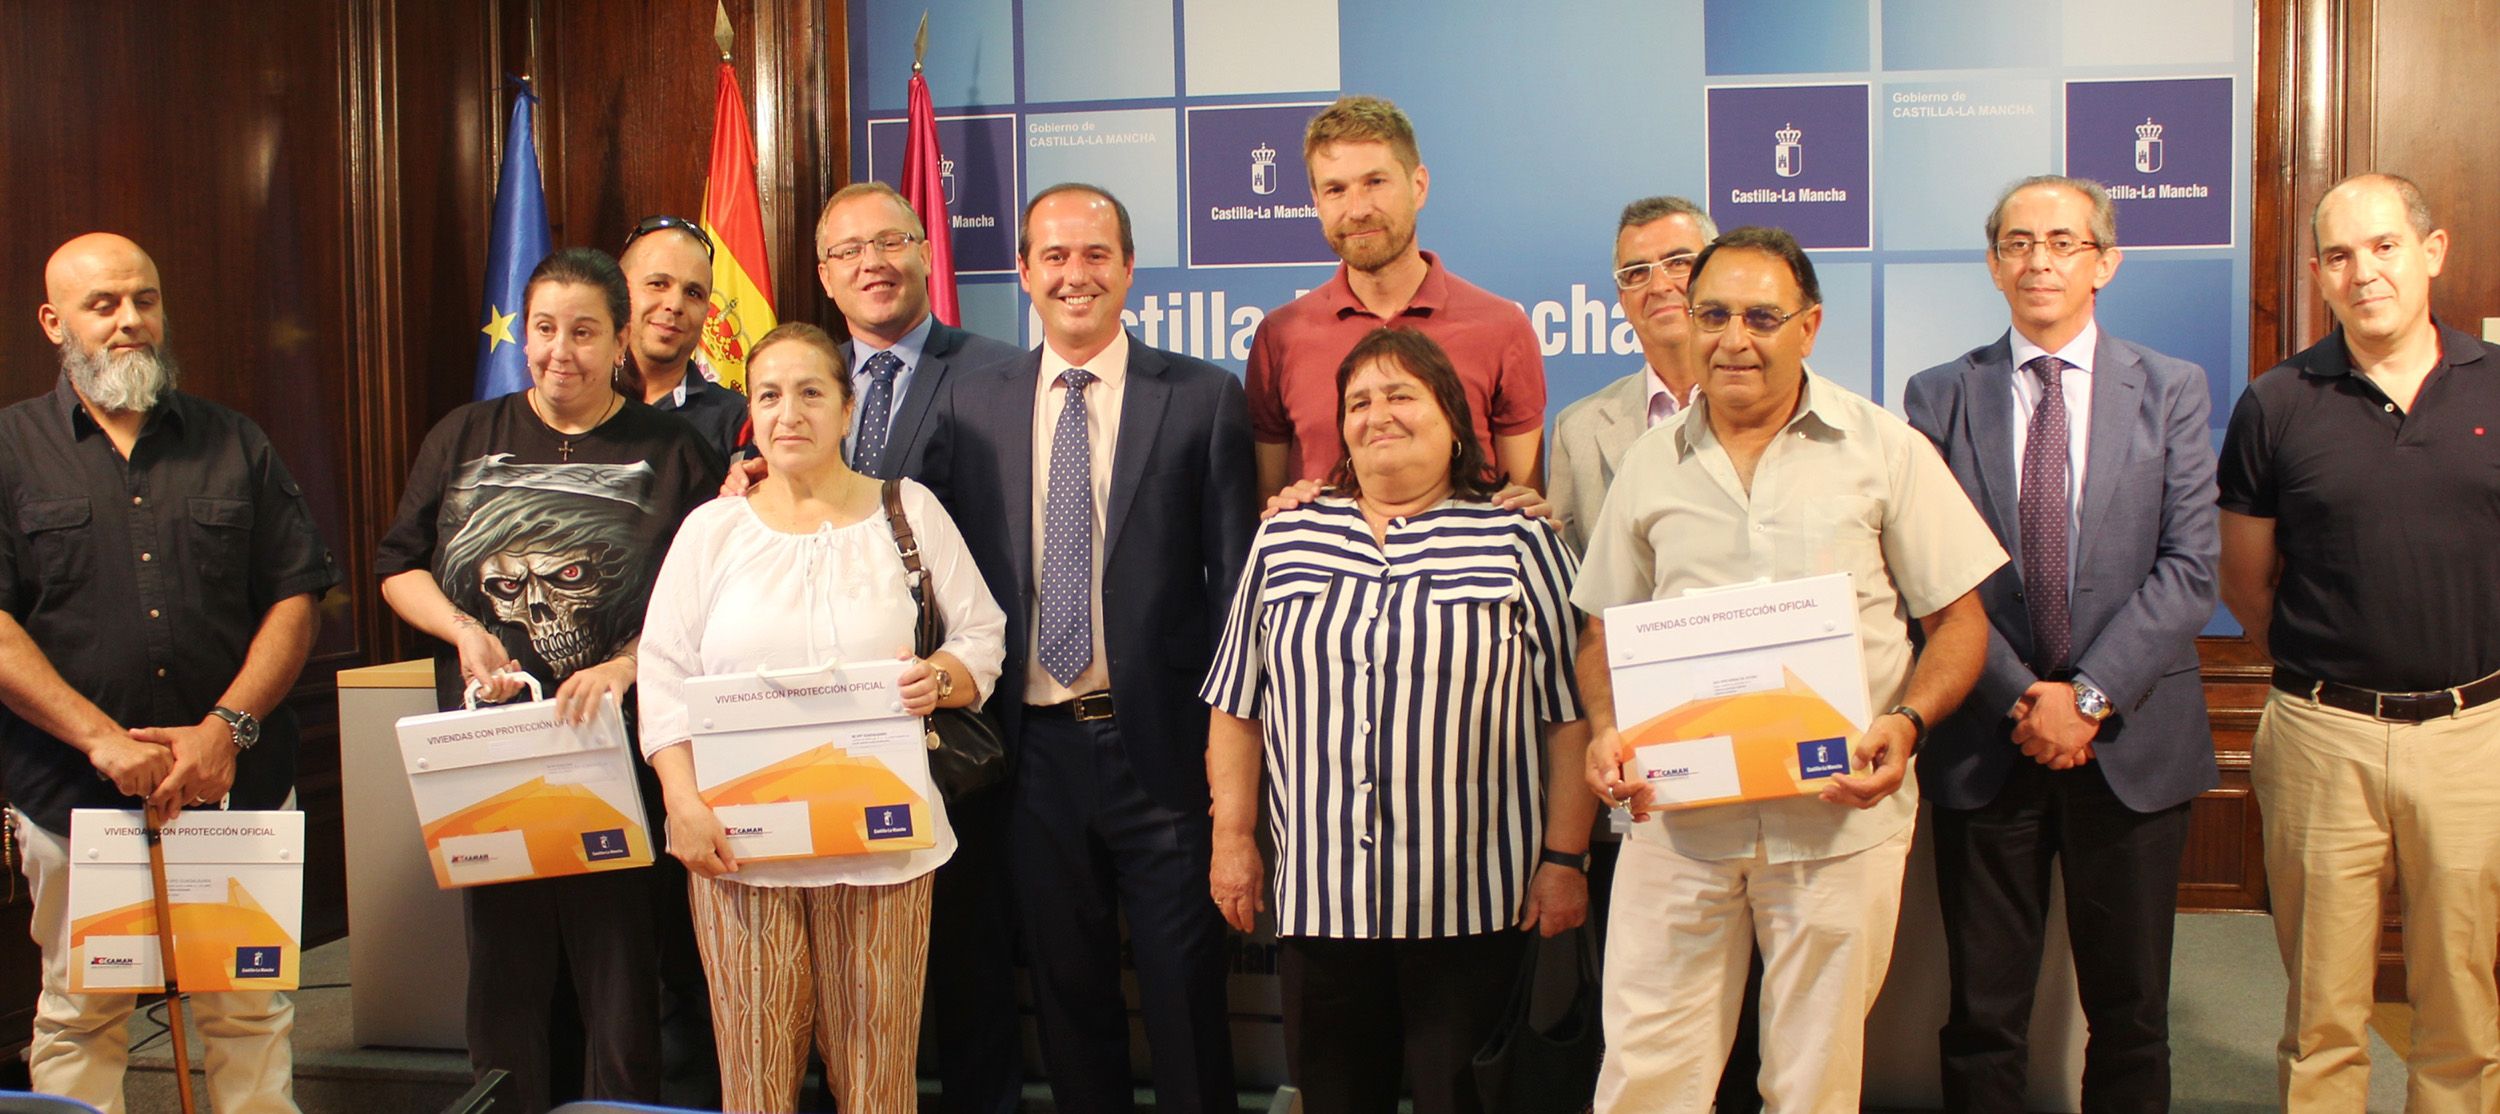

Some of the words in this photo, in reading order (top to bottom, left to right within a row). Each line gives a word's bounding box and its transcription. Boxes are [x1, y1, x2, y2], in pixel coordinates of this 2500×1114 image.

[1892, 92, 1949, 103] Gobierno
[1951, 91, 1968, 102] de
[1892, 106, 1976, 118] CASTILLA-LA
[1978, 104, 2035, 116] MANCHA
[1029, 123, 1079, 134] Gobierno
[1081, 121, 1096, 132] de
[1029, 135, 1103, 148] CASTILLA-LA
[1105, 133, 1158, 145] MANCHA
[1731, 188, 1796, 204] Castilla-La
[1798, 187, 1847, 202] Mancha
[2104, 185, 2156, 200] stilla-La
[2158, 184, 2208, 199] Mancha
[1211, 206, 1271, 220] Castilla-La
[1273, 204, 1318, 219] Mancha
[952, 214, 995, 228] Mancha
[1515, 284, 1644, 357] cha
[1636, 617, 1688, 634] VIVIENDAS
[1689, 614, 1711, 626] CON
[1712, 604, 1777, 622] PROTECCIÓN
[1778, 598, 1818, 612] OFICIAL
[715, 692, 764, 704] VIVIENDAS
[765, 689, 786, 700] CON
[787, 684, 848, 698] PROTECCIÓN
[848, 680, 886, 692] OFICIAL
[427, 731, 473, 745] VIVIENDAS
[474, 729, 494, 740] CON
[495, 719, 553, 736] PROTECCIÓN
[104, 827, 149, 836] VIVIENDA
[178, 825, 239, 836] PROTECCIÓN
[241, 827, 276, 836] OFICIAL
